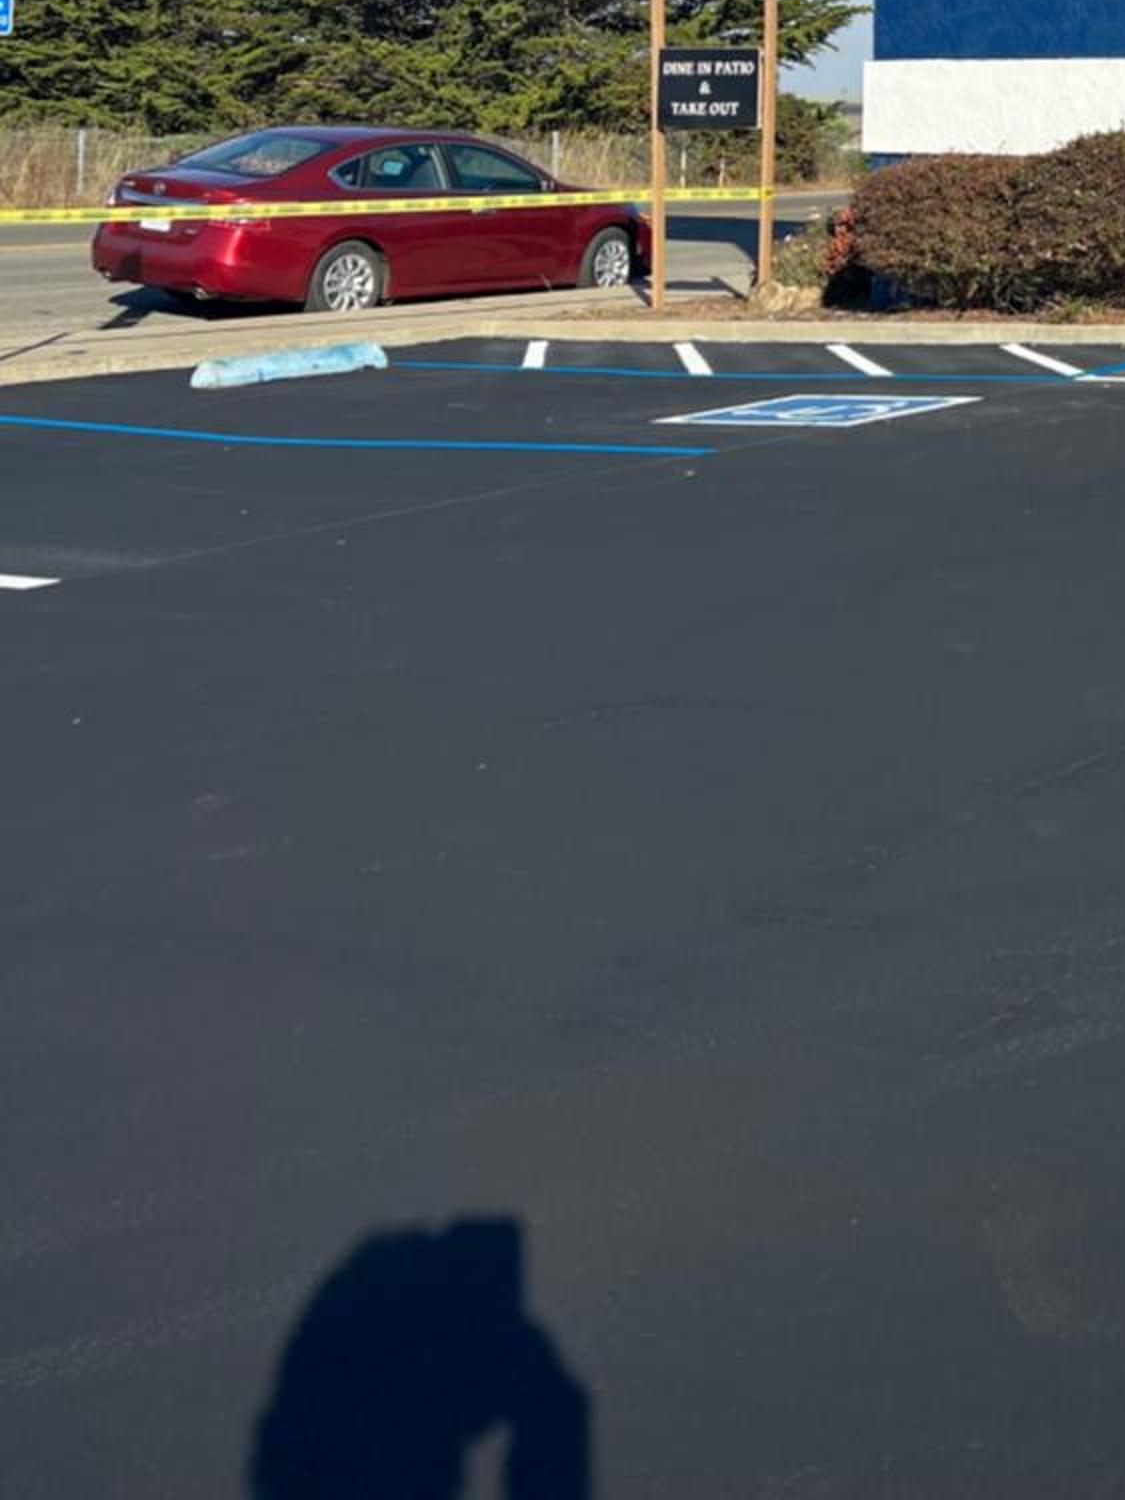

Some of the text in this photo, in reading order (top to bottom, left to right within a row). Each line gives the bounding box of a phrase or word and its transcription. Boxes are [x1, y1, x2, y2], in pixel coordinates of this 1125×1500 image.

[663, 61, 754, 75] DINE IN PATIO
[671, 102, 739, 115] TAKE OUT
